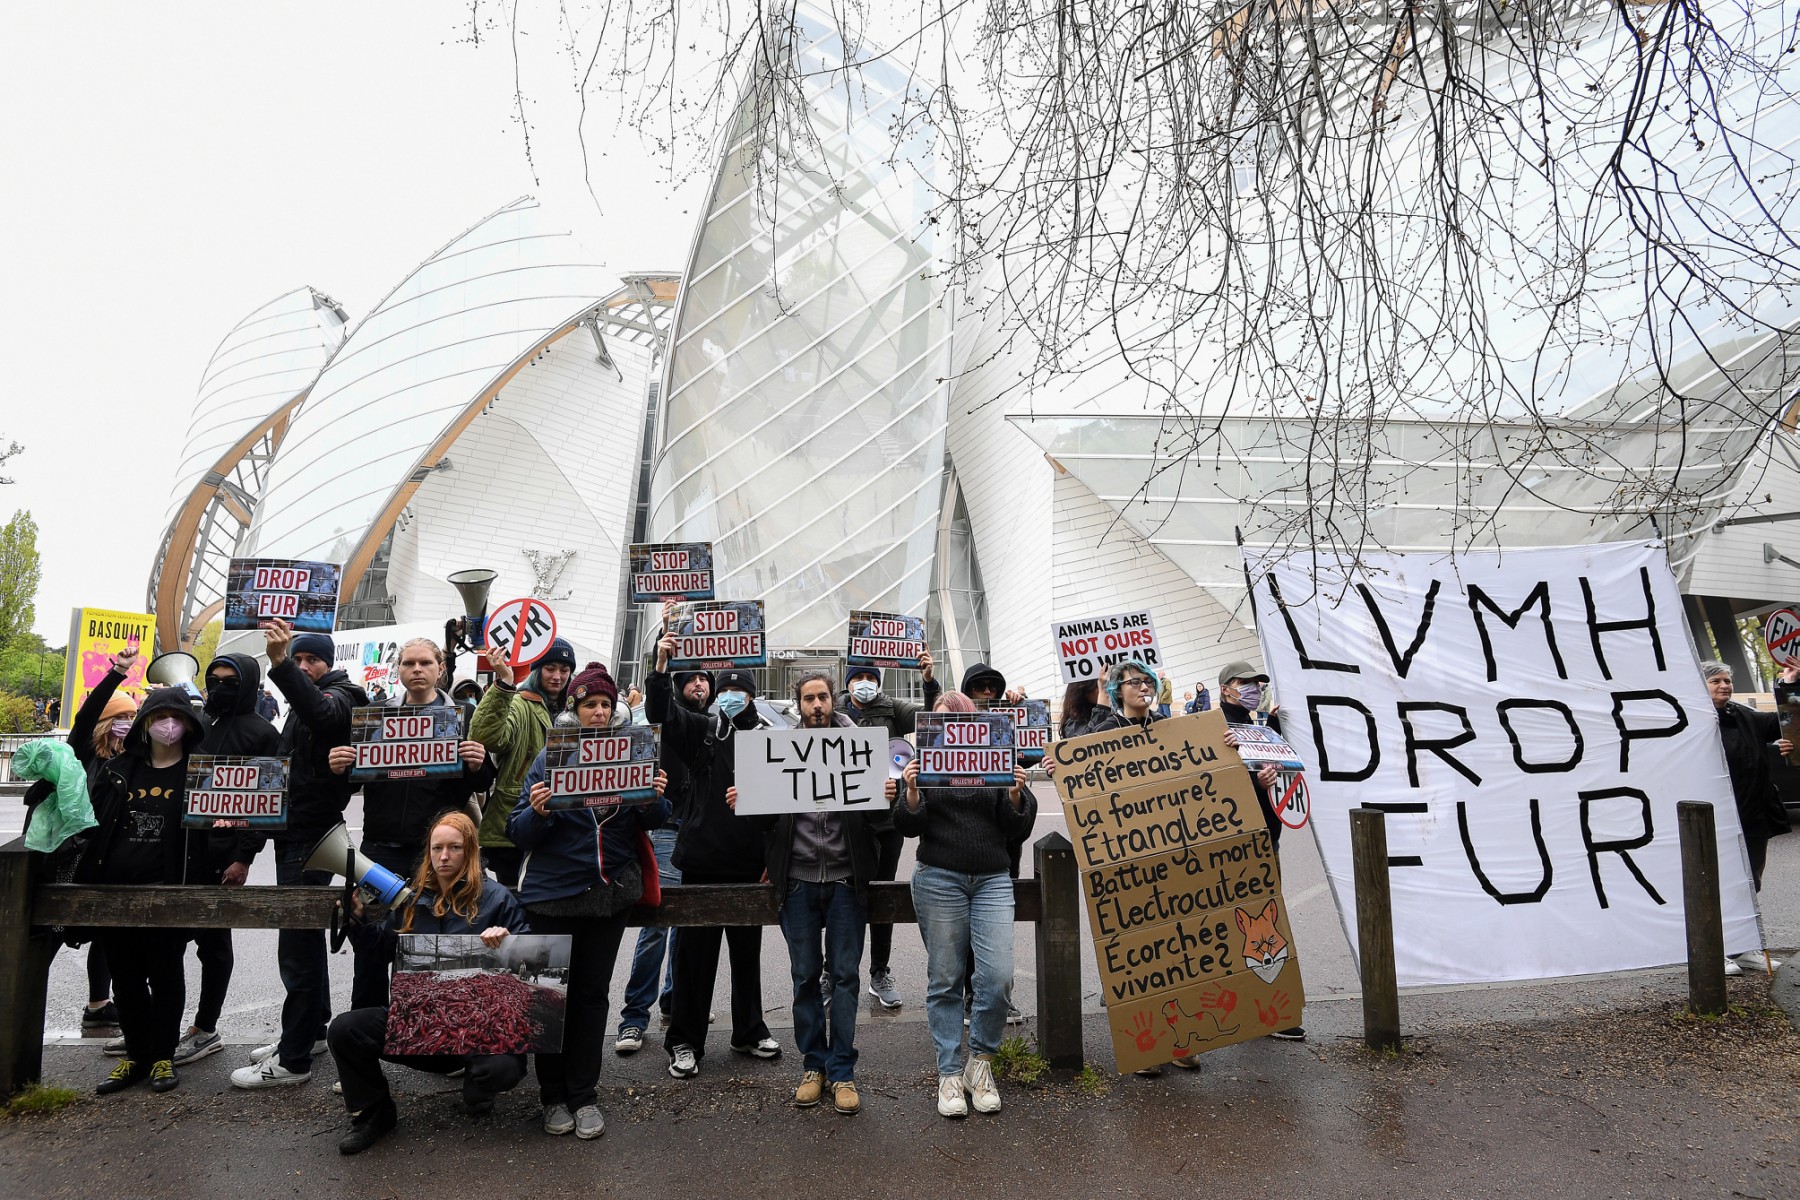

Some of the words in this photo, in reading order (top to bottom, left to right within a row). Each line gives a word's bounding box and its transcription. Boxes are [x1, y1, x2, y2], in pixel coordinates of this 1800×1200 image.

[653, 552, 687, 569] STOP
[256, 568, 308, 590] DROP
[636, 572, 709, 592] FOURRURE
[259, 594, 297, 616] FUR
[88, 620, 148, 641] BASQUIAT
[489, 606, 551, 659] FUR
[696, 611, 736, 631] STOP
[873, 620, 904, 636] STOP
[1058, 618, 1119, 639] ANIMALS
[1122, 613, 1149, 629] ARE
[1267, 567, 1667, 682] LVMH
[674, 635, 760, 658] FOURRURE
[767, 650, 794, 660] TTON
[1061, 636, 1098, 658] NOT
[1104, 628, 1153, 650] OURS
[1065, 658, 1093, 678] TO
[385, 717, 431, 738] STOP
[946, 723, 988, 744] STOP
[1234, 729, 1264, 741] STOP
[1306, 689, 1689, 787] DROP
[358, 742, 456, 766] FOURRURE
[582, 738, 628, 762] STOP
[766, 735, 873, 768] LVMH
[1055, 728, 1158, 766] Comment
[1240, 743, 1297, 760] OURRURE
[923, 751, 1011, 772] FOURRURE
[1063, 740, 1218, 799] préférerais-tu
[214, 767, 257, 787] STOP
[553, 765, 652, 794] FOURRURE
[781, 768, 872, 805] TUE
[190, 793, 280, 814] FOURRURE
[1073, 804, 1104, 828] la
[1109, 772, 1217, 828] fourrure?
[1274, 772, 1306, 814] FUR
[1082, 797, 1243, 866] Étranglée?
[1089, 862, 1168, 897] Battue
[1185, 849, 1204, 875] à
[1209, 831, 1272, 868] mort?
[1096, 863, 1275, 935] Électrocutée?
[1105, 915, 1228, 973] Écorchée
[1112, 943, 1233, 999] vivante?
